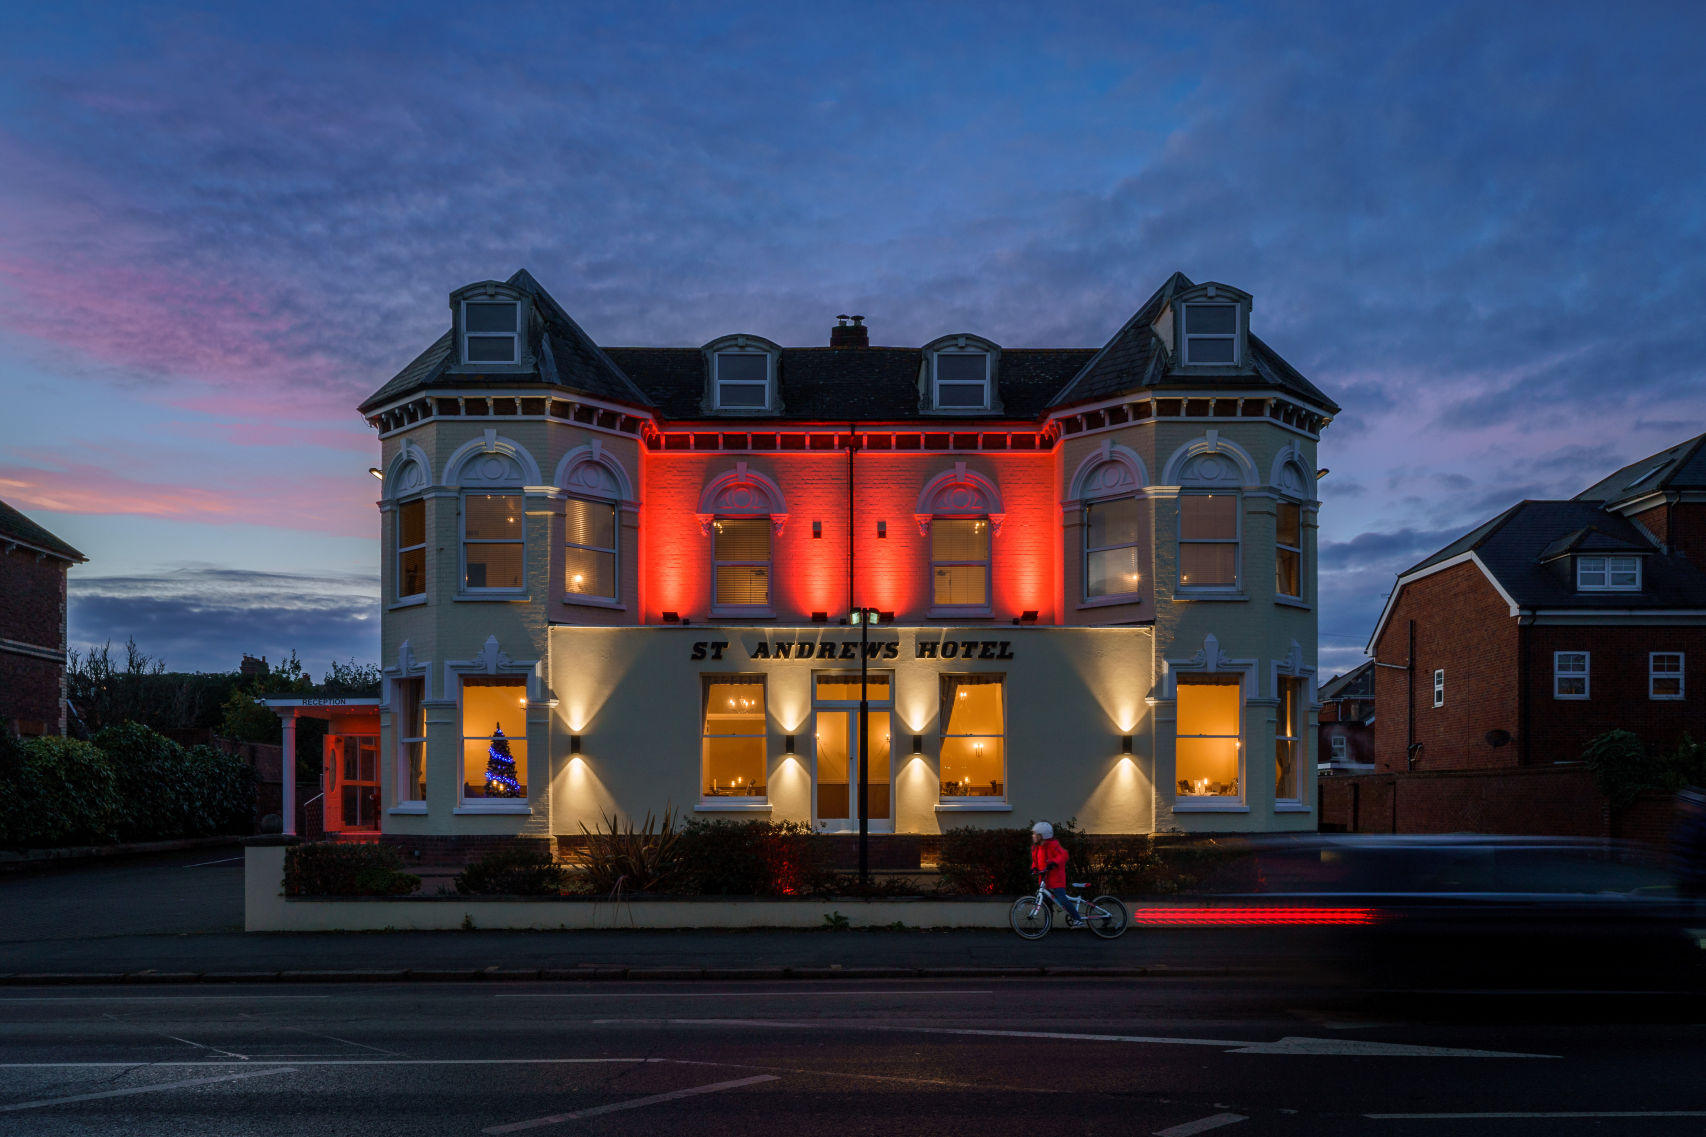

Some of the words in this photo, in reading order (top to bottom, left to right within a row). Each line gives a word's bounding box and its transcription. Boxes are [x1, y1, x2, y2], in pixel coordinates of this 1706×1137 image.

[690, 641, 729, 660] ST
[751, 641, 900, 660] ANDREWS
[915, 641, 1014, 660] HOTEL
